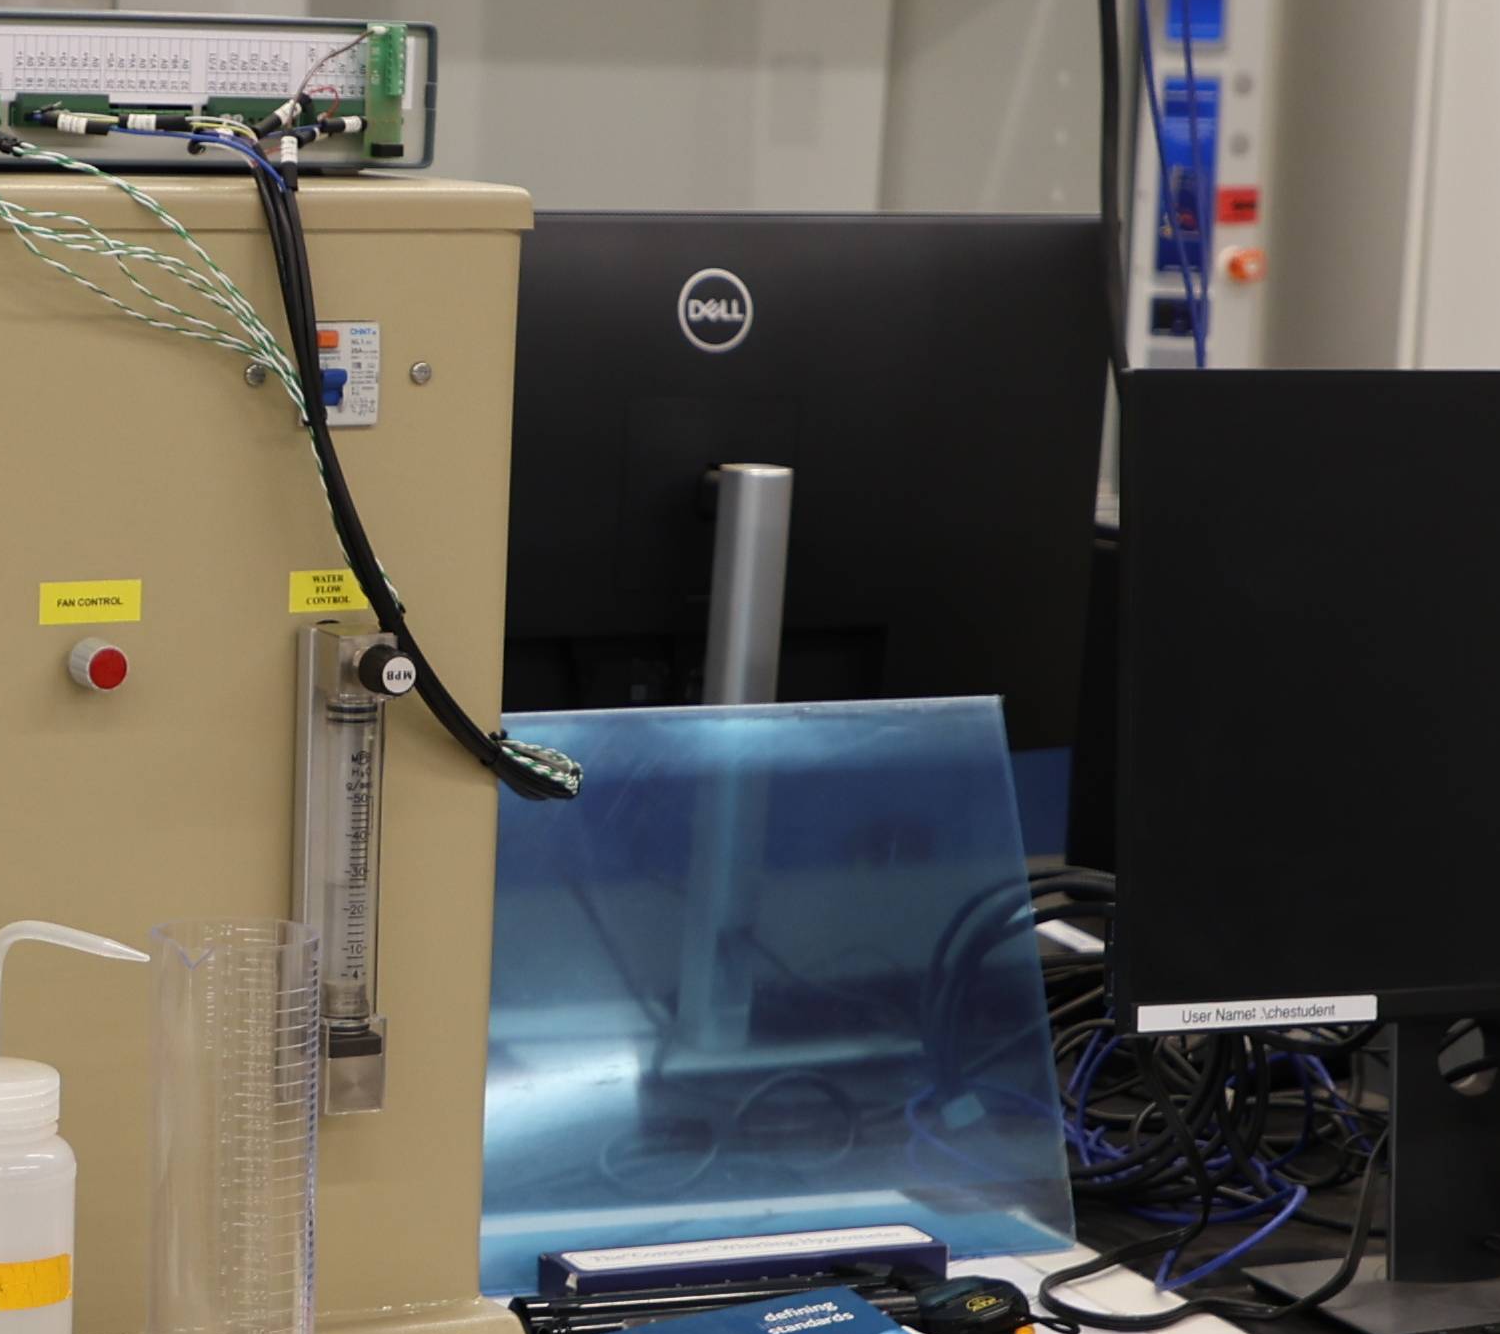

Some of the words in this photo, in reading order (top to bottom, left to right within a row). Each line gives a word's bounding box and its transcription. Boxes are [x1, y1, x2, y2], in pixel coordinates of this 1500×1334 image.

[687, 297, 745, 323] DELL
[312, 574, 344, 583] WATER
[316, 586, 342, 594] FLOW
[56, 598, 75, 607] FAN
[78, 596, 123, 607] CONTROL
[306, 596, 351, 605] CONTROL
[1182, 1009, 1212, 1024] User
[1215, 1006, 1257, 1022] Name:
[763, 1301, 839, 1323] defining
